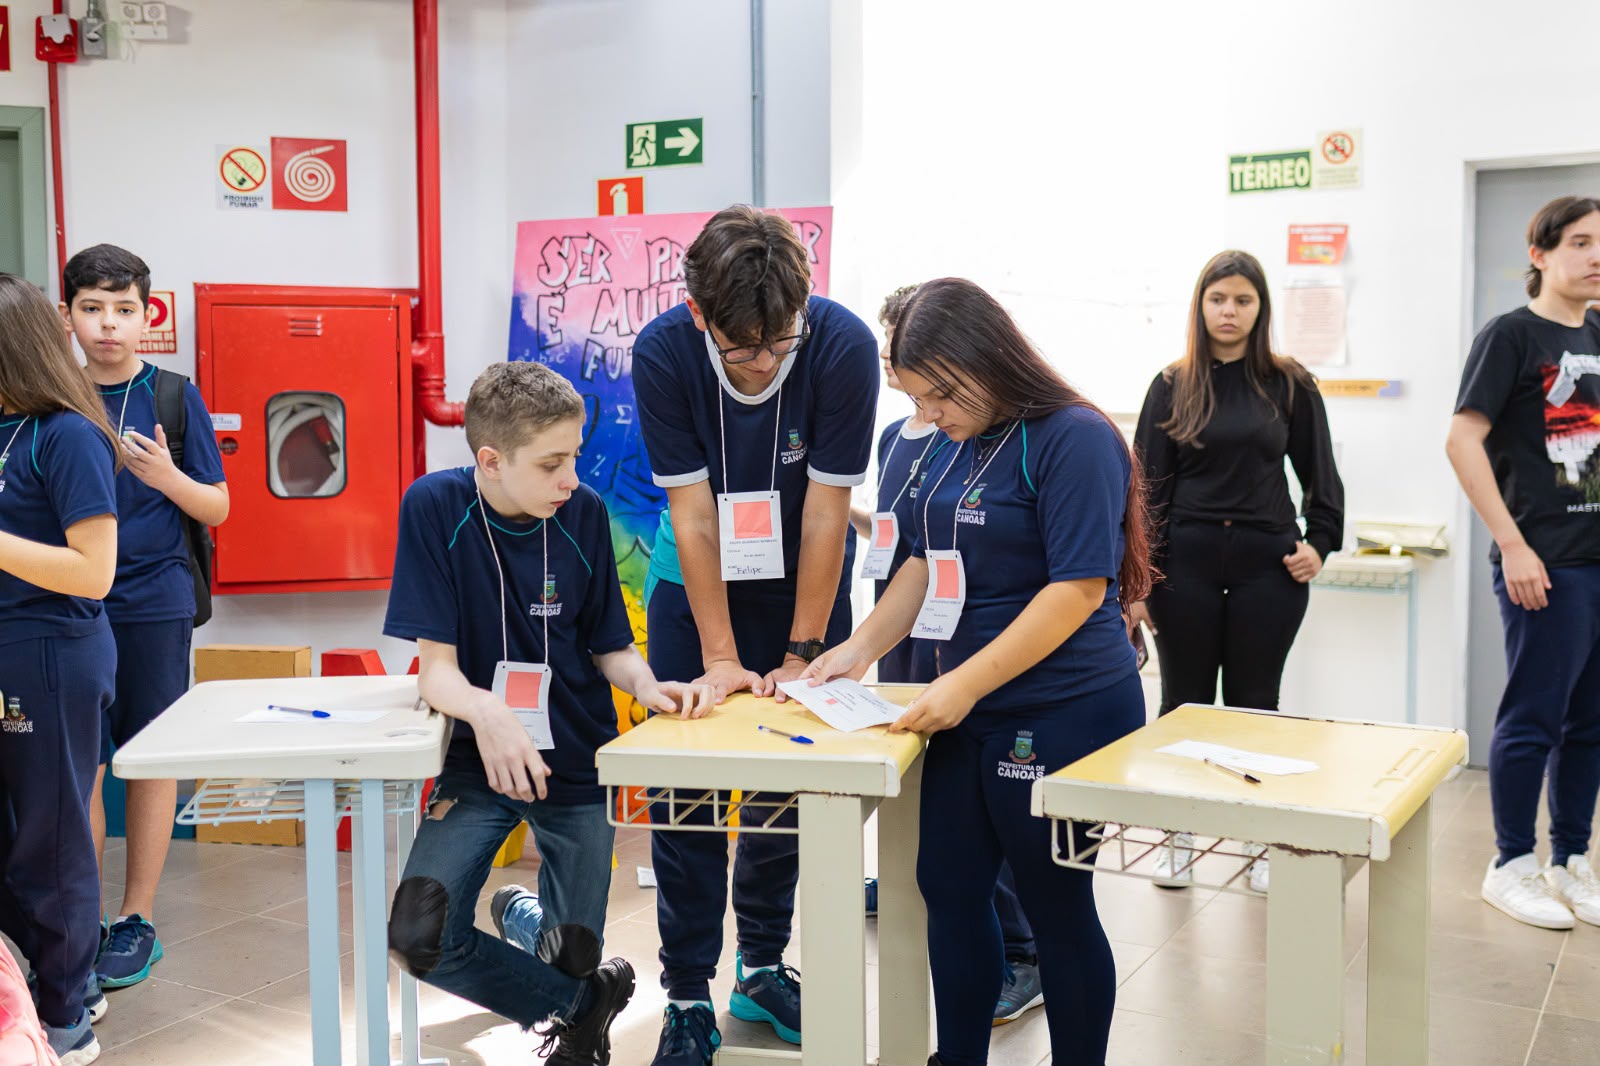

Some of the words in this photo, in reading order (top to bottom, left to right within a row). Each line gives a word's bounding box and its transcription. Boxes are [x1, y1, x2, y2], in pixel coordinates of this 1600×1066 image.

[1231, 155, 1310, 191] TÉRREO
[537, 232, 612, 289] SER
[998, 760, 1035, 771] PREFEITURA
[998, 767, 1044, 781] CANOAS
